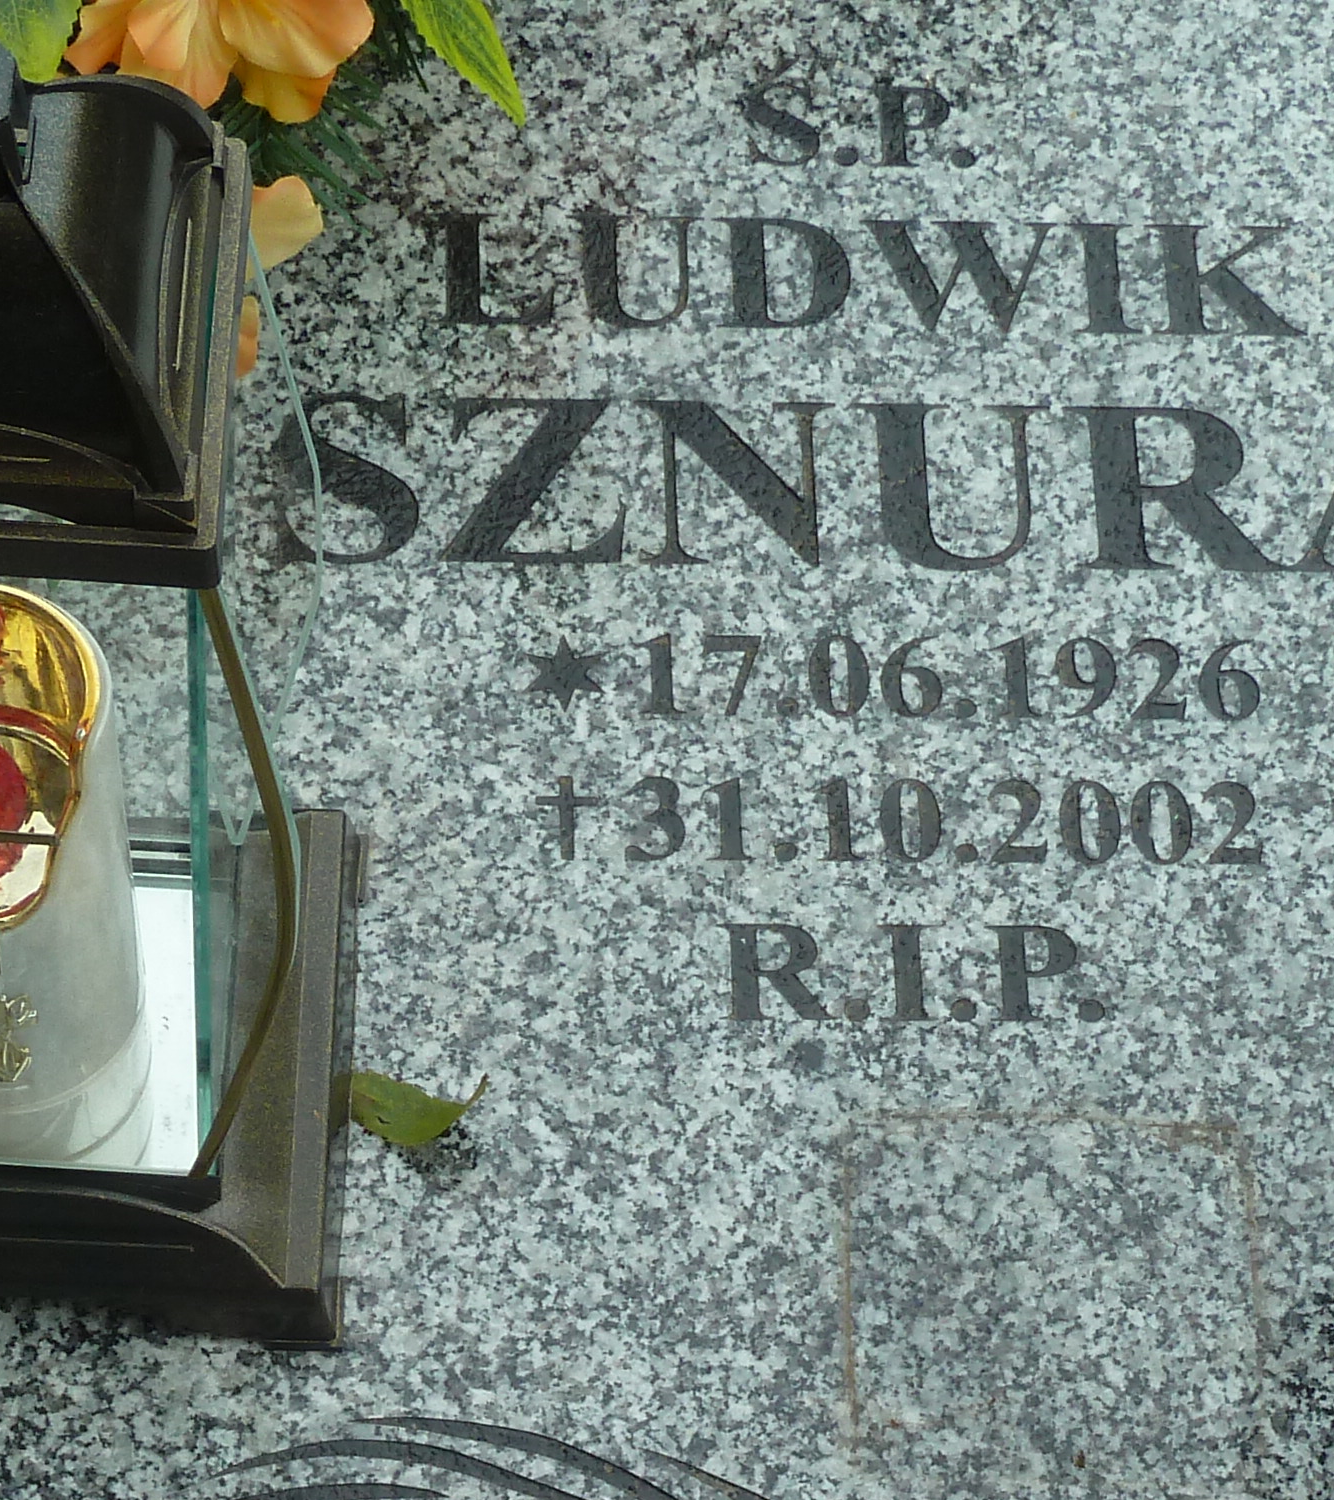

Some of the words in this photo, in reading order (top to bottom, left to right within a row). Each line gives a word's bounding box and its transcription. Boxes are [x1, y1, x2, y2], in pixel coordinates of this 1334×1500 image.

[441, 212, 1309, 336] LUDWIK
[639, 634, 1263, 720] 17.06.1926
[623, 776, 1265, 866] 31.10.2002
[721, 922, 1105, 1022] R.I.P.
